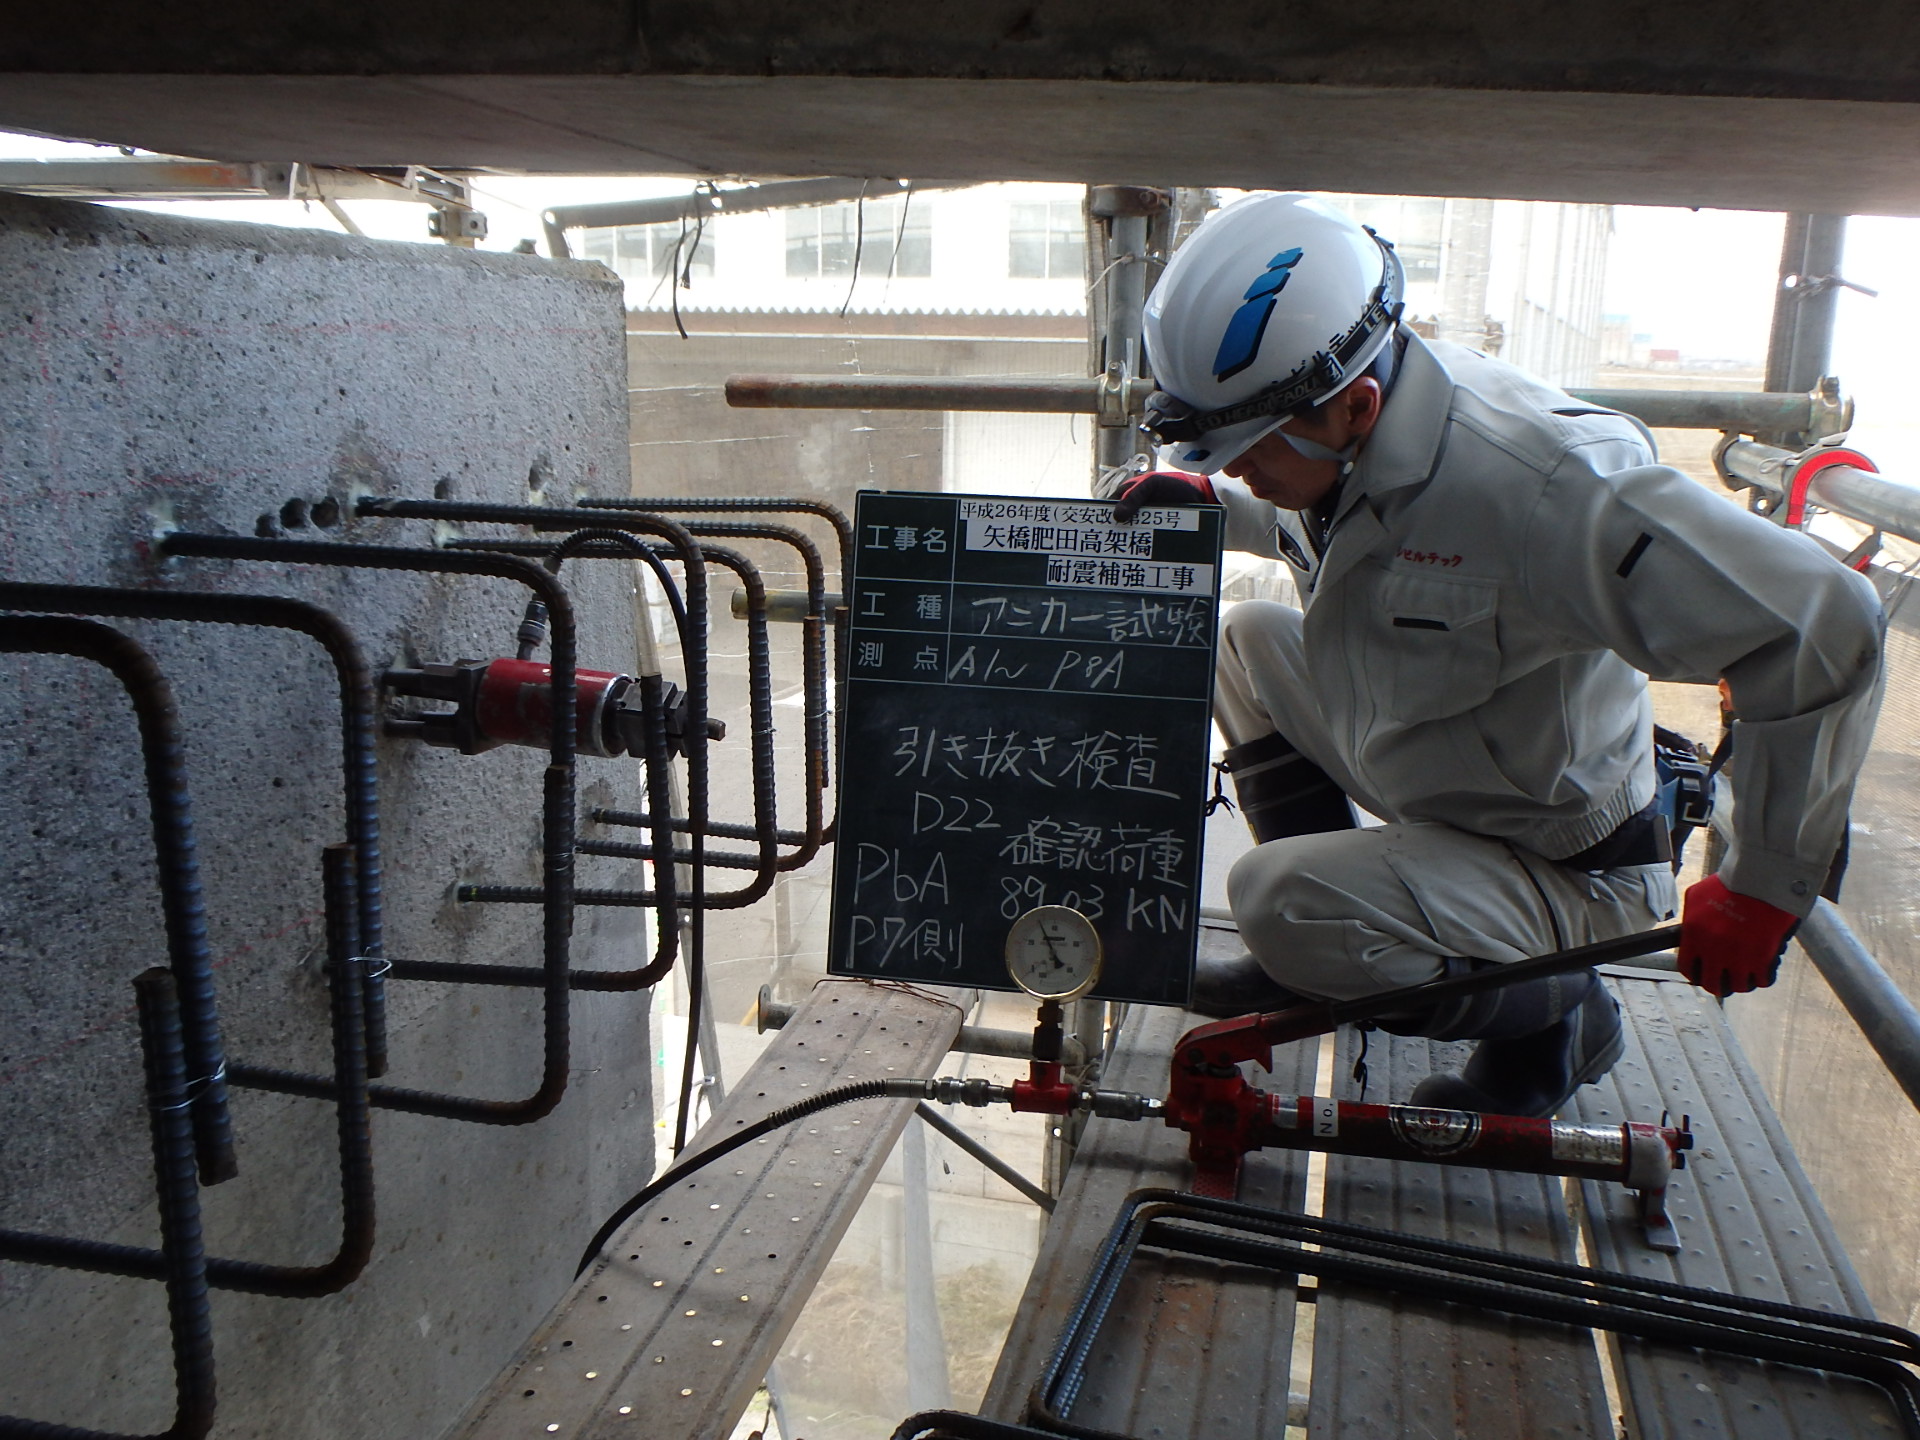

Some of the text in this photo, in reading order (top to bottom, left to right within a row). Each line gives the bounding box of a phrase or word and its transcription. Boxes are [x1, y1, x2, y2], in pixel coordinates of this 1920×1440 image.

[1363, 309, 1386, 333] LE
[960, 501, 1181, 531] 平成26年度(交安改第25号
[865, 524, 947, 553] 工事名
[983, 523, 1153, 556] 矢橋肥田高架橋
[1048, 558, 1195, 591] 耐震補強工事
[895, 726, 1181, 799] 引き抜き検査
[913, 791, 1001, 835] D22
[1000, 815, 1188, 888] 確認荷重
[1001, 875, 1104, 920] 8903
[846, 915, 963, 969] P7側
